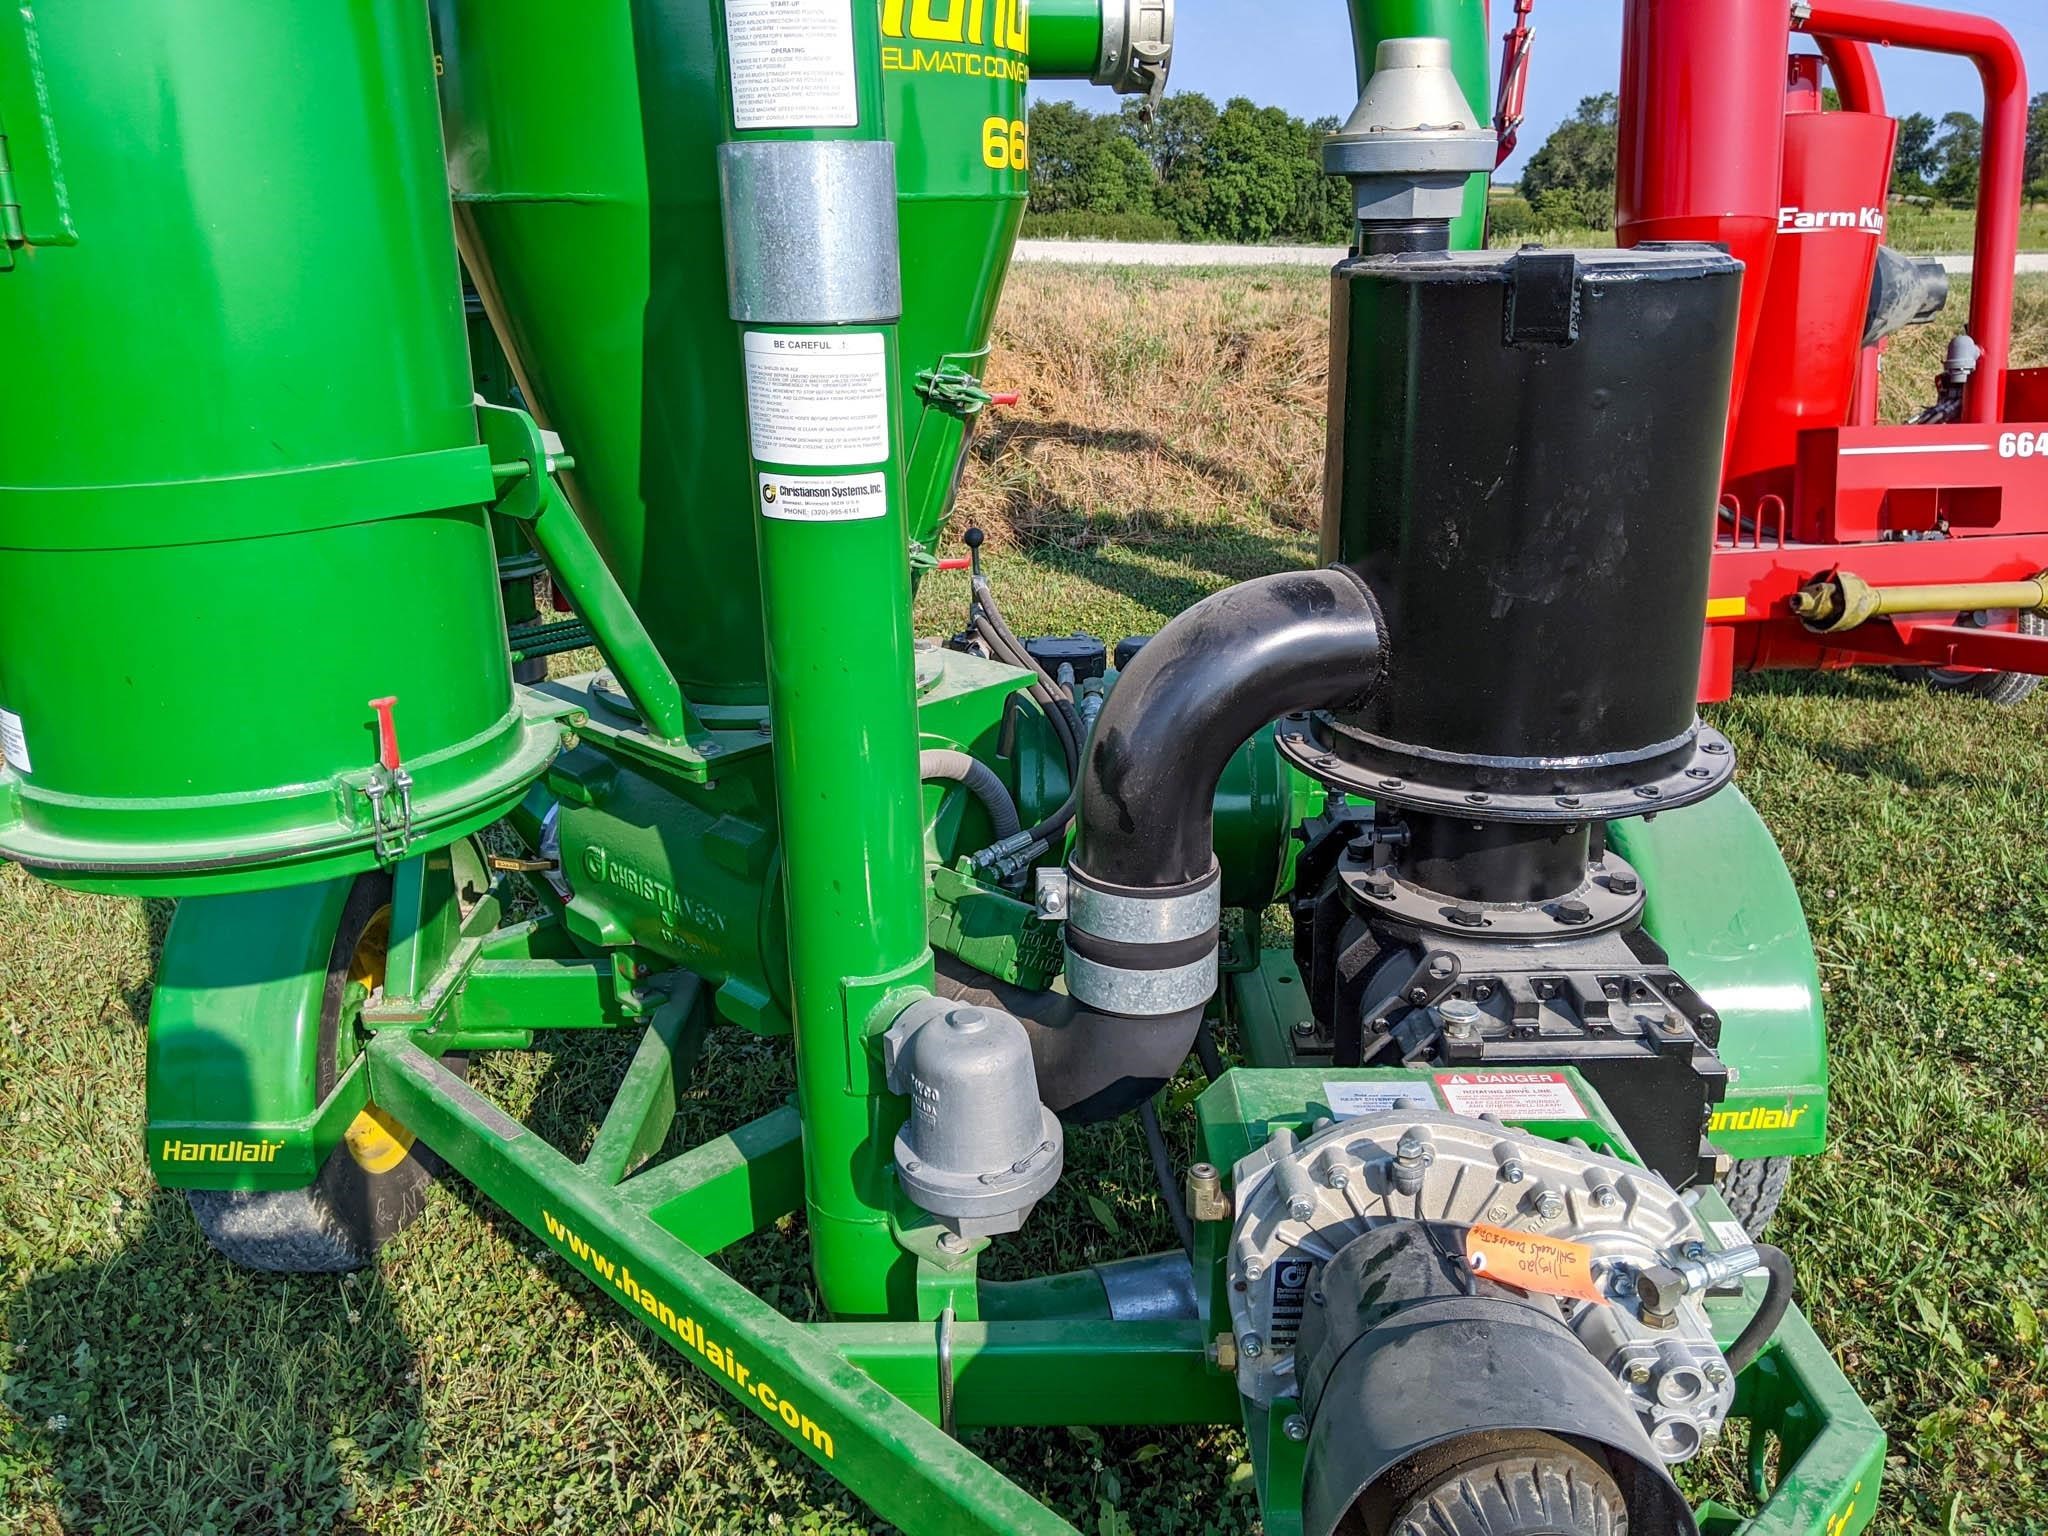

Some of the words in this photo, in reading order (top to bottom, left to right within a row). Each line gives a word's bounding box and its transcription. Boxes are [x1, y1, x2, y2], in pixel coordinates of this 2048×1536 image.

[982, 116, 1029, 171] 66
[1779, 207, 1856, 229] Farm
[773, 340, 785, 348] BE
[787, 340, 832, 350] CAREFUL
[780, 485, 831, 498] Christianson
[1476, 1074, 1553, 1084] DANGER
[162, 1140, 283, 1162] Handlair
[542, 1209, 835, 1459] www.handlair.com
